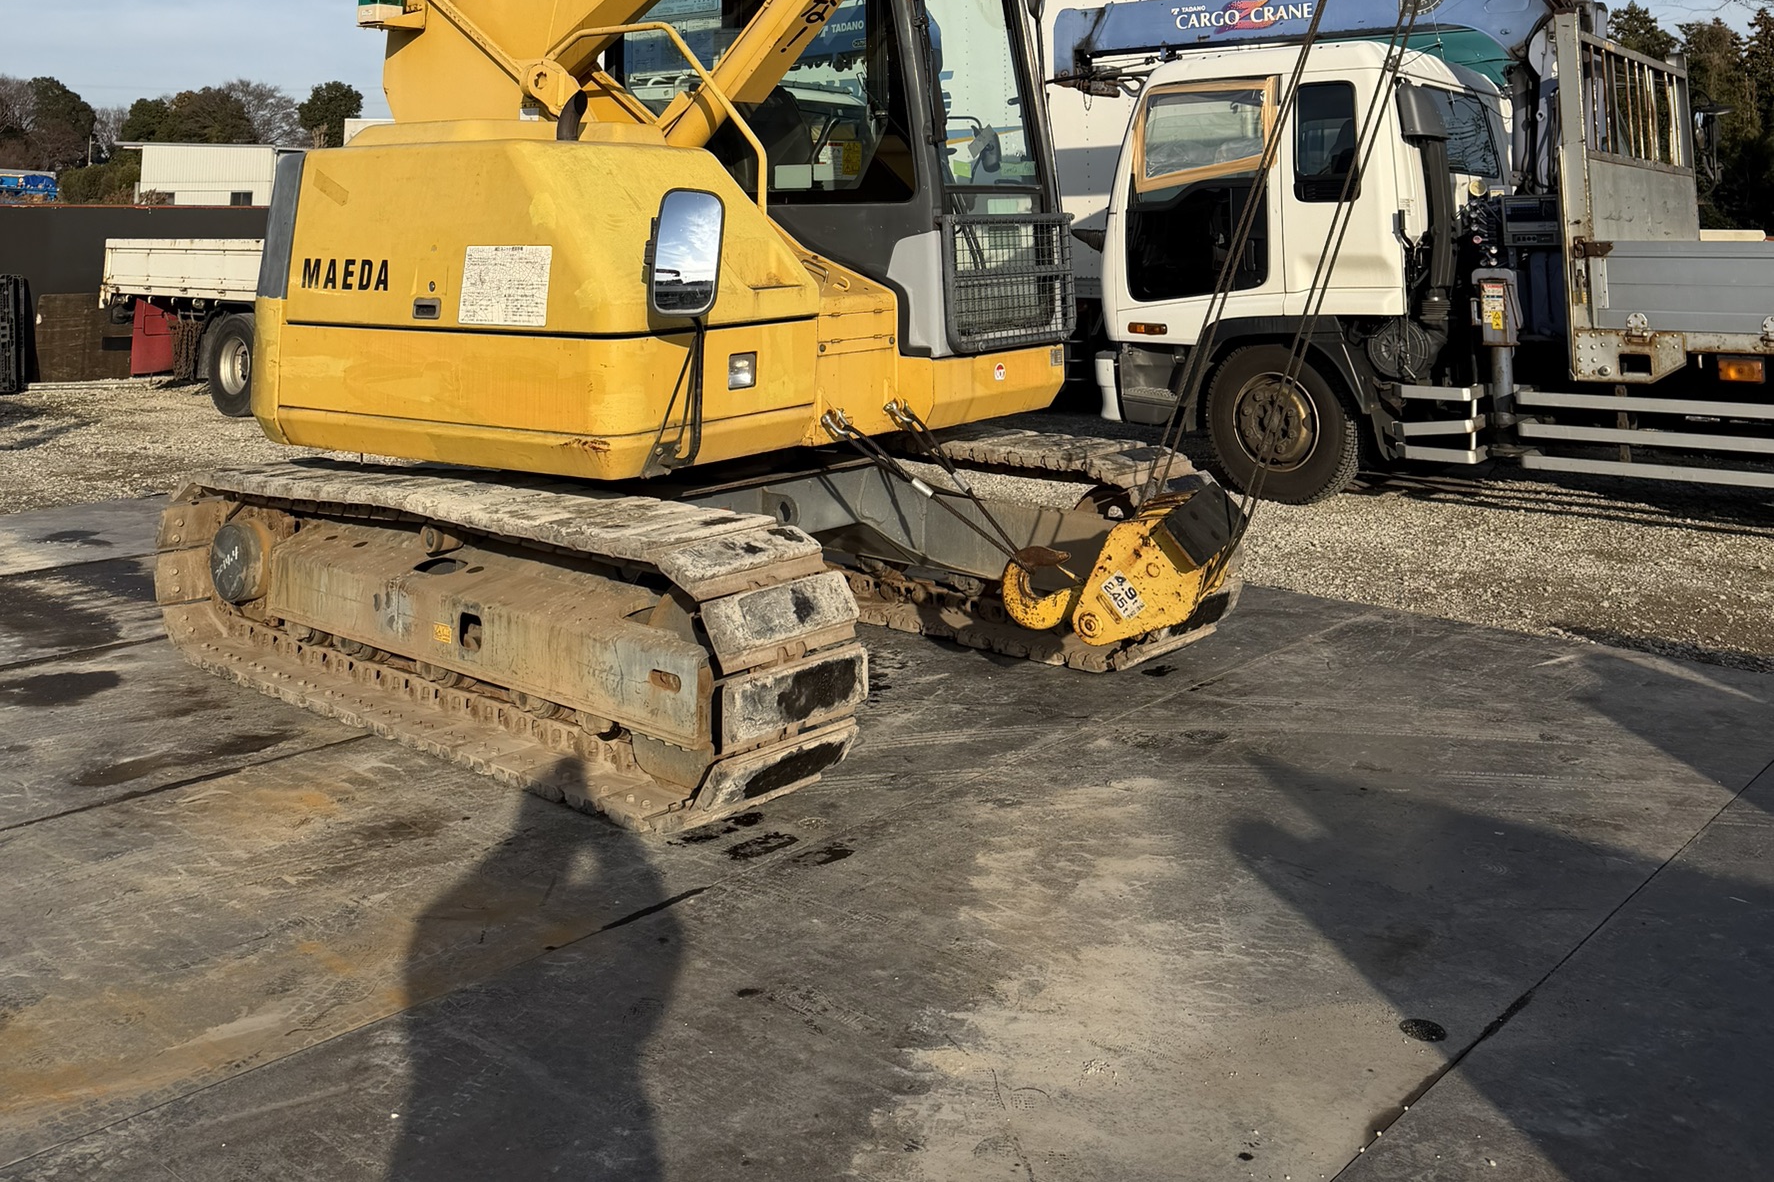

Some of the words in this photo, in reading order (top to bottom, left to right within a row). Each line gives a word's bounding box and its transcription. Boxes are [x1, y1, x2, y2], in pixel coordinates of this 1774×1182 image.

[1175, 9, 1240, 31] CARGO
[1250, 2, 1313, 23] CRANE
[1181, 4, 1207, 14] TADANO
[831, 20, 865, 34] TADANO
[301, 258, 389, 291] MAEDA
